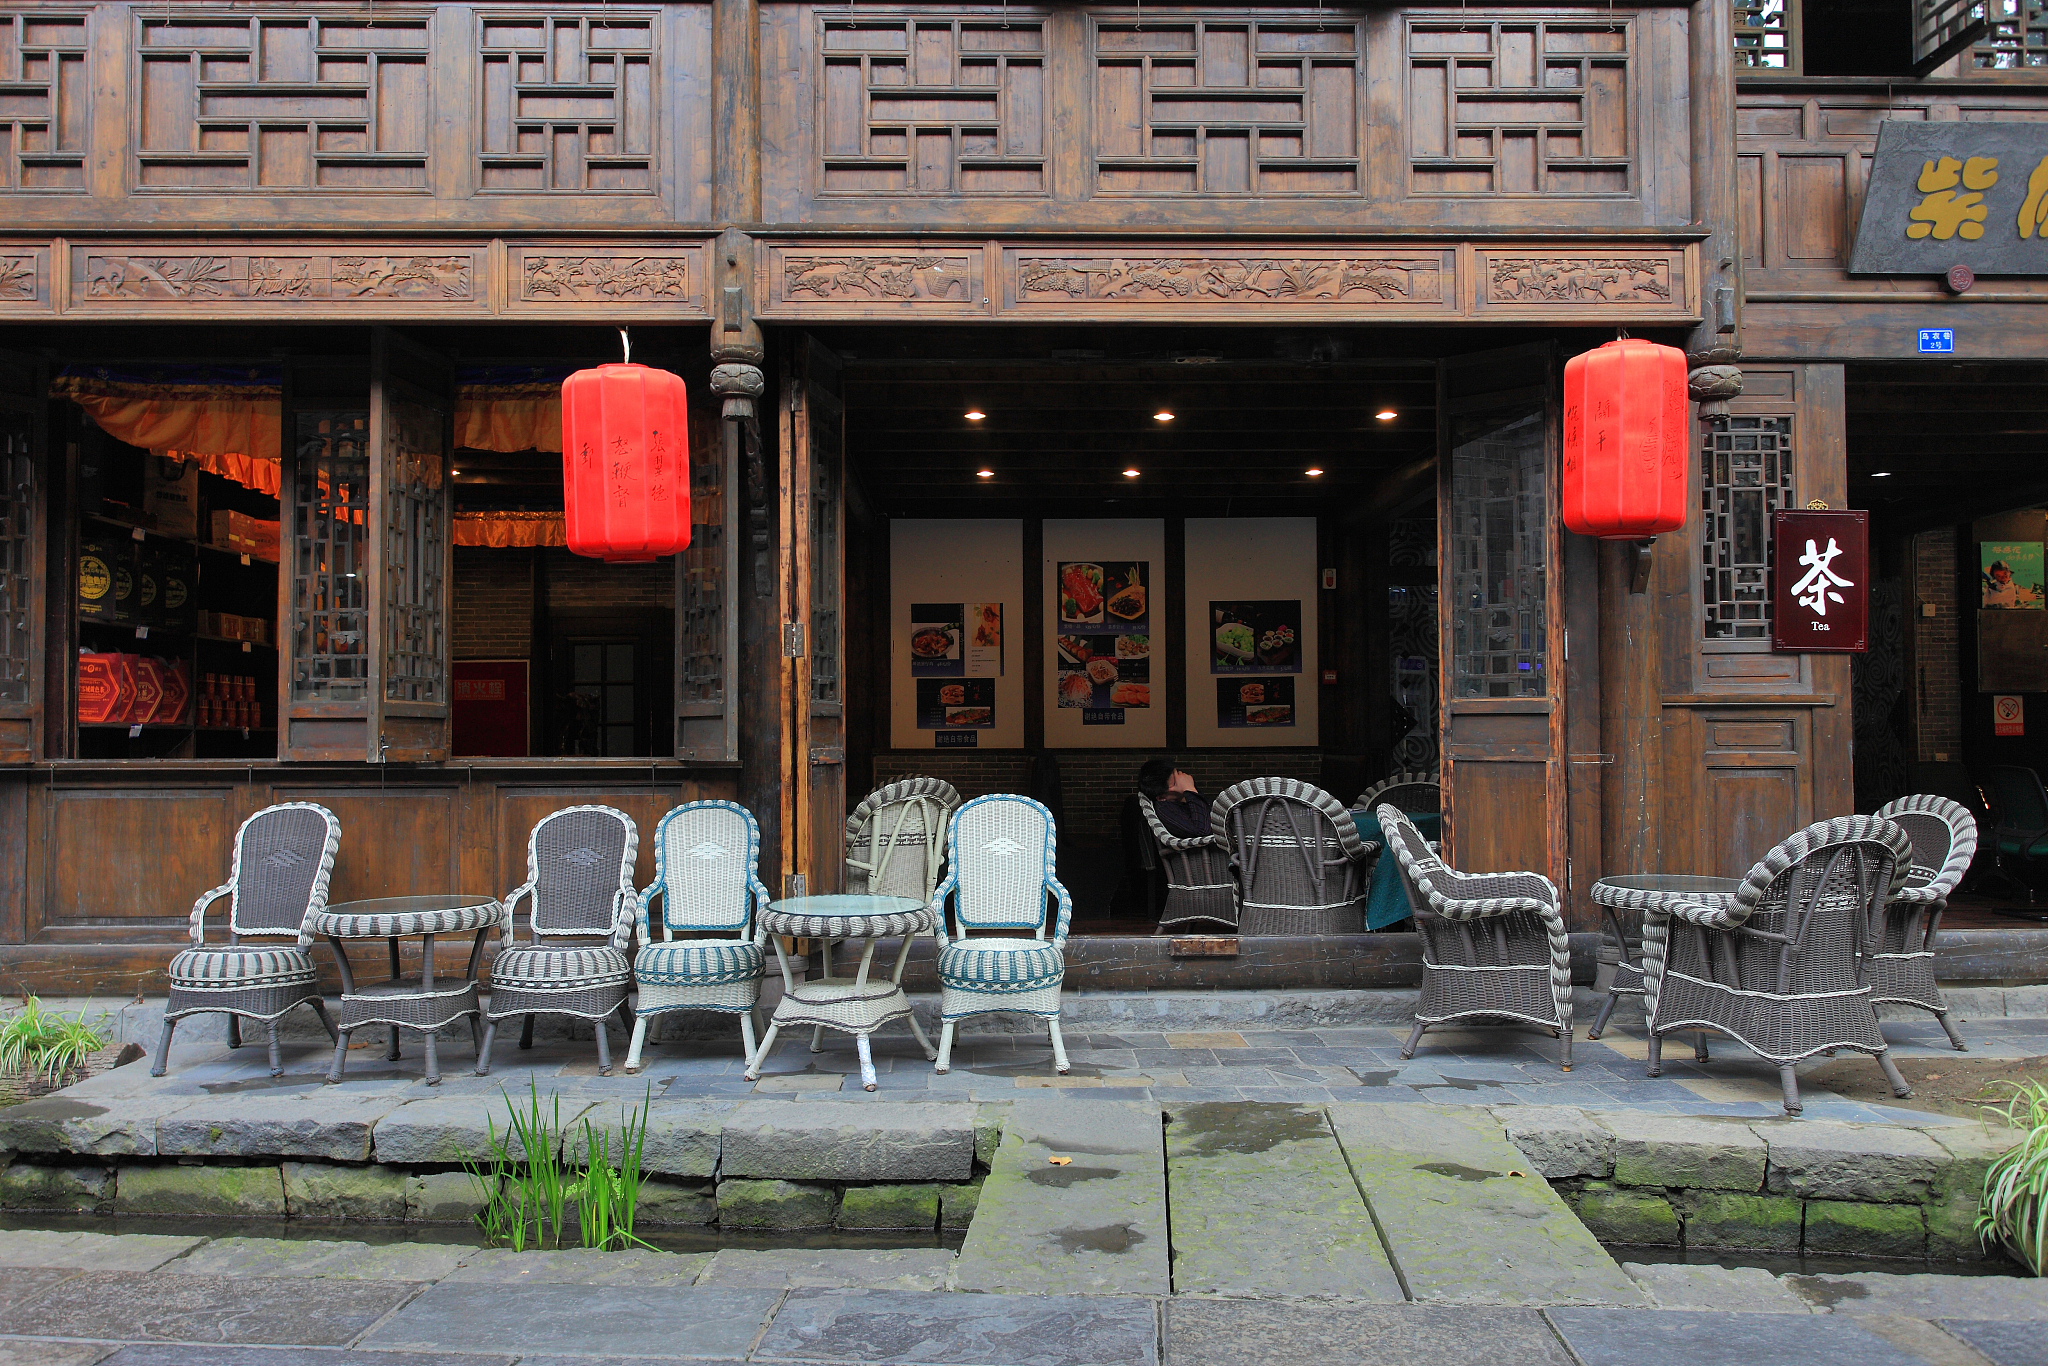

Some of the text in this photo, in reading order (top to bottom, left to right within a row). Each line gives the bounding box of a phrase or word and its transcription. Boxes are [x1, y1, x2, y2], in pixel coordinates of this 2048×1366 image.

[1930, 341, 1942, 350] 2号
[1790, 537, 1855, 616] 茶
[1811, 621, 1831, 631] Tea
[457, 681, 503, 695] 消火栓
